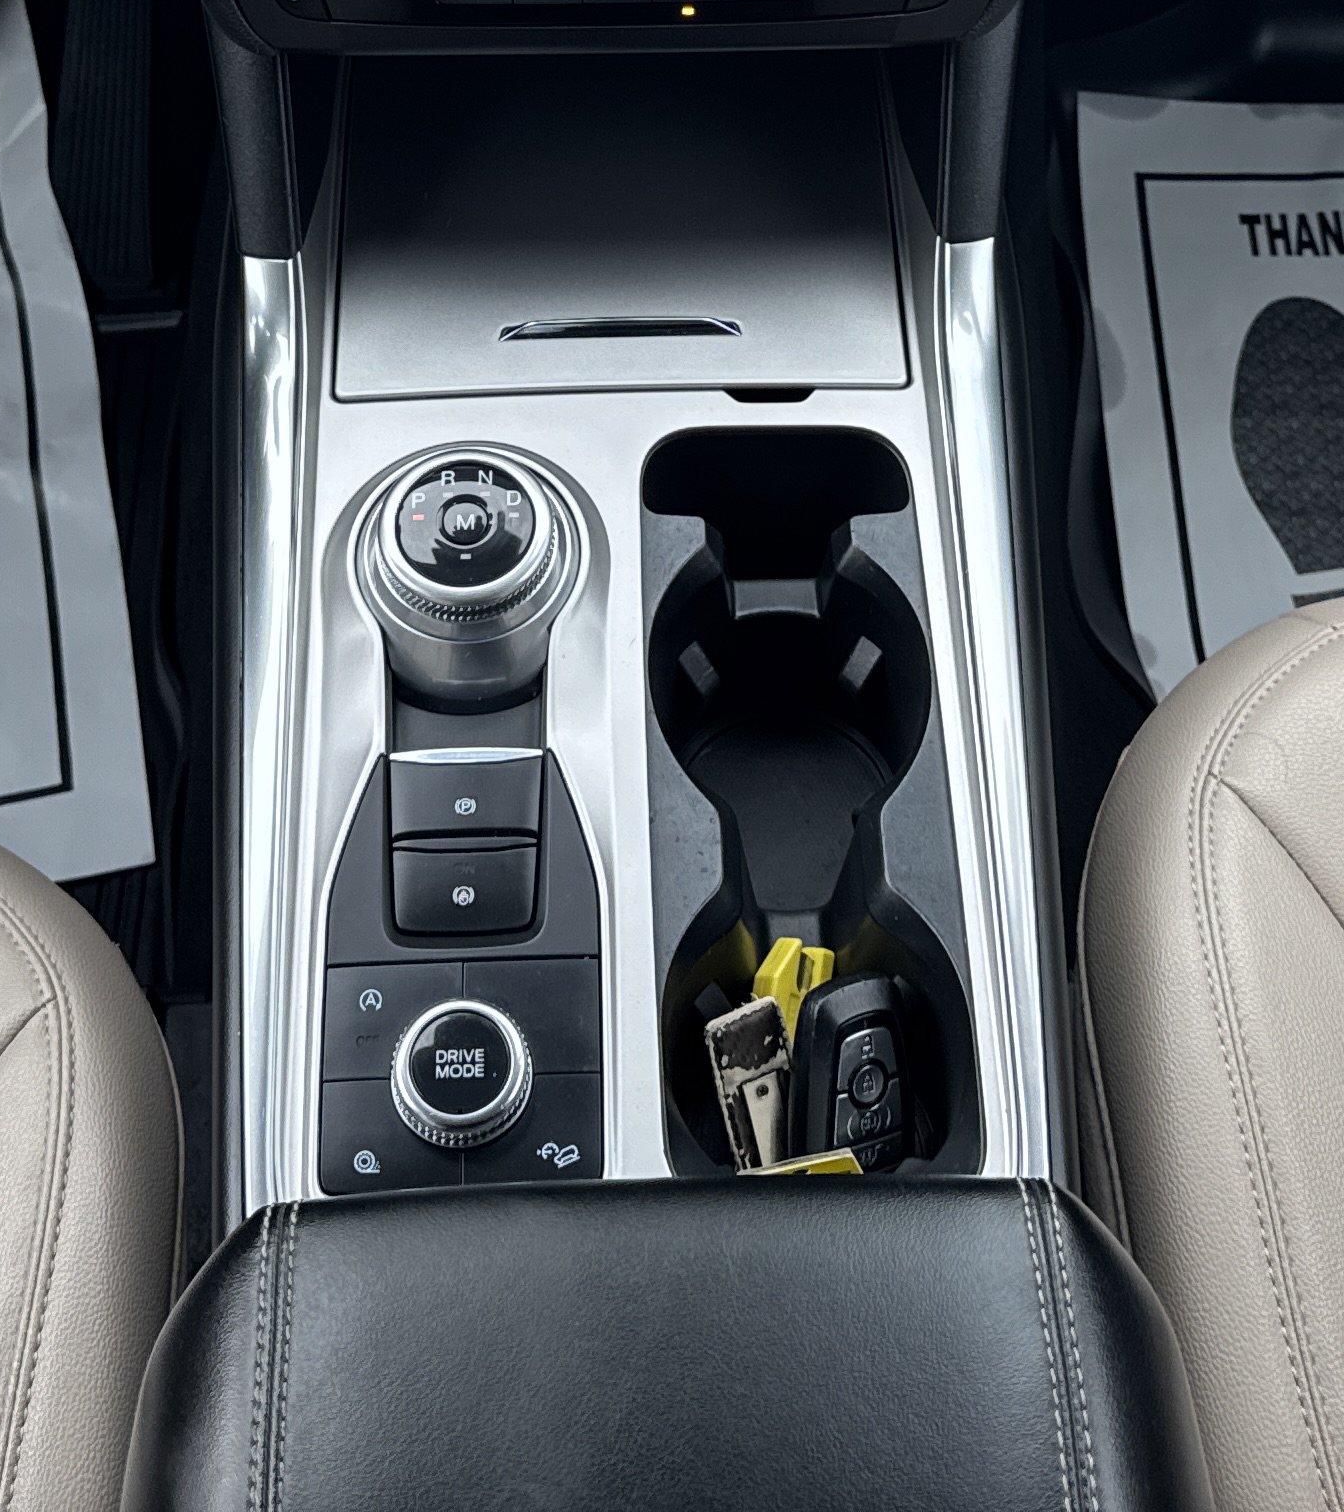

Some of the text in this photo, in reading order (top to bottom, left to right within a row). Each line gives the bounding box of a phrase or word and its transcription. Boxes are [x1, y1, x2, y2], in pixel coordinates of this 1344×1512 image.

[440, 470, 494, 486] R N
[412, 490, 522, 509] P D
[456, 514, 476, 531] M
[434, 1048, 485, 1064] DRIVE
[434, 1063, 485, 1079] MODE
